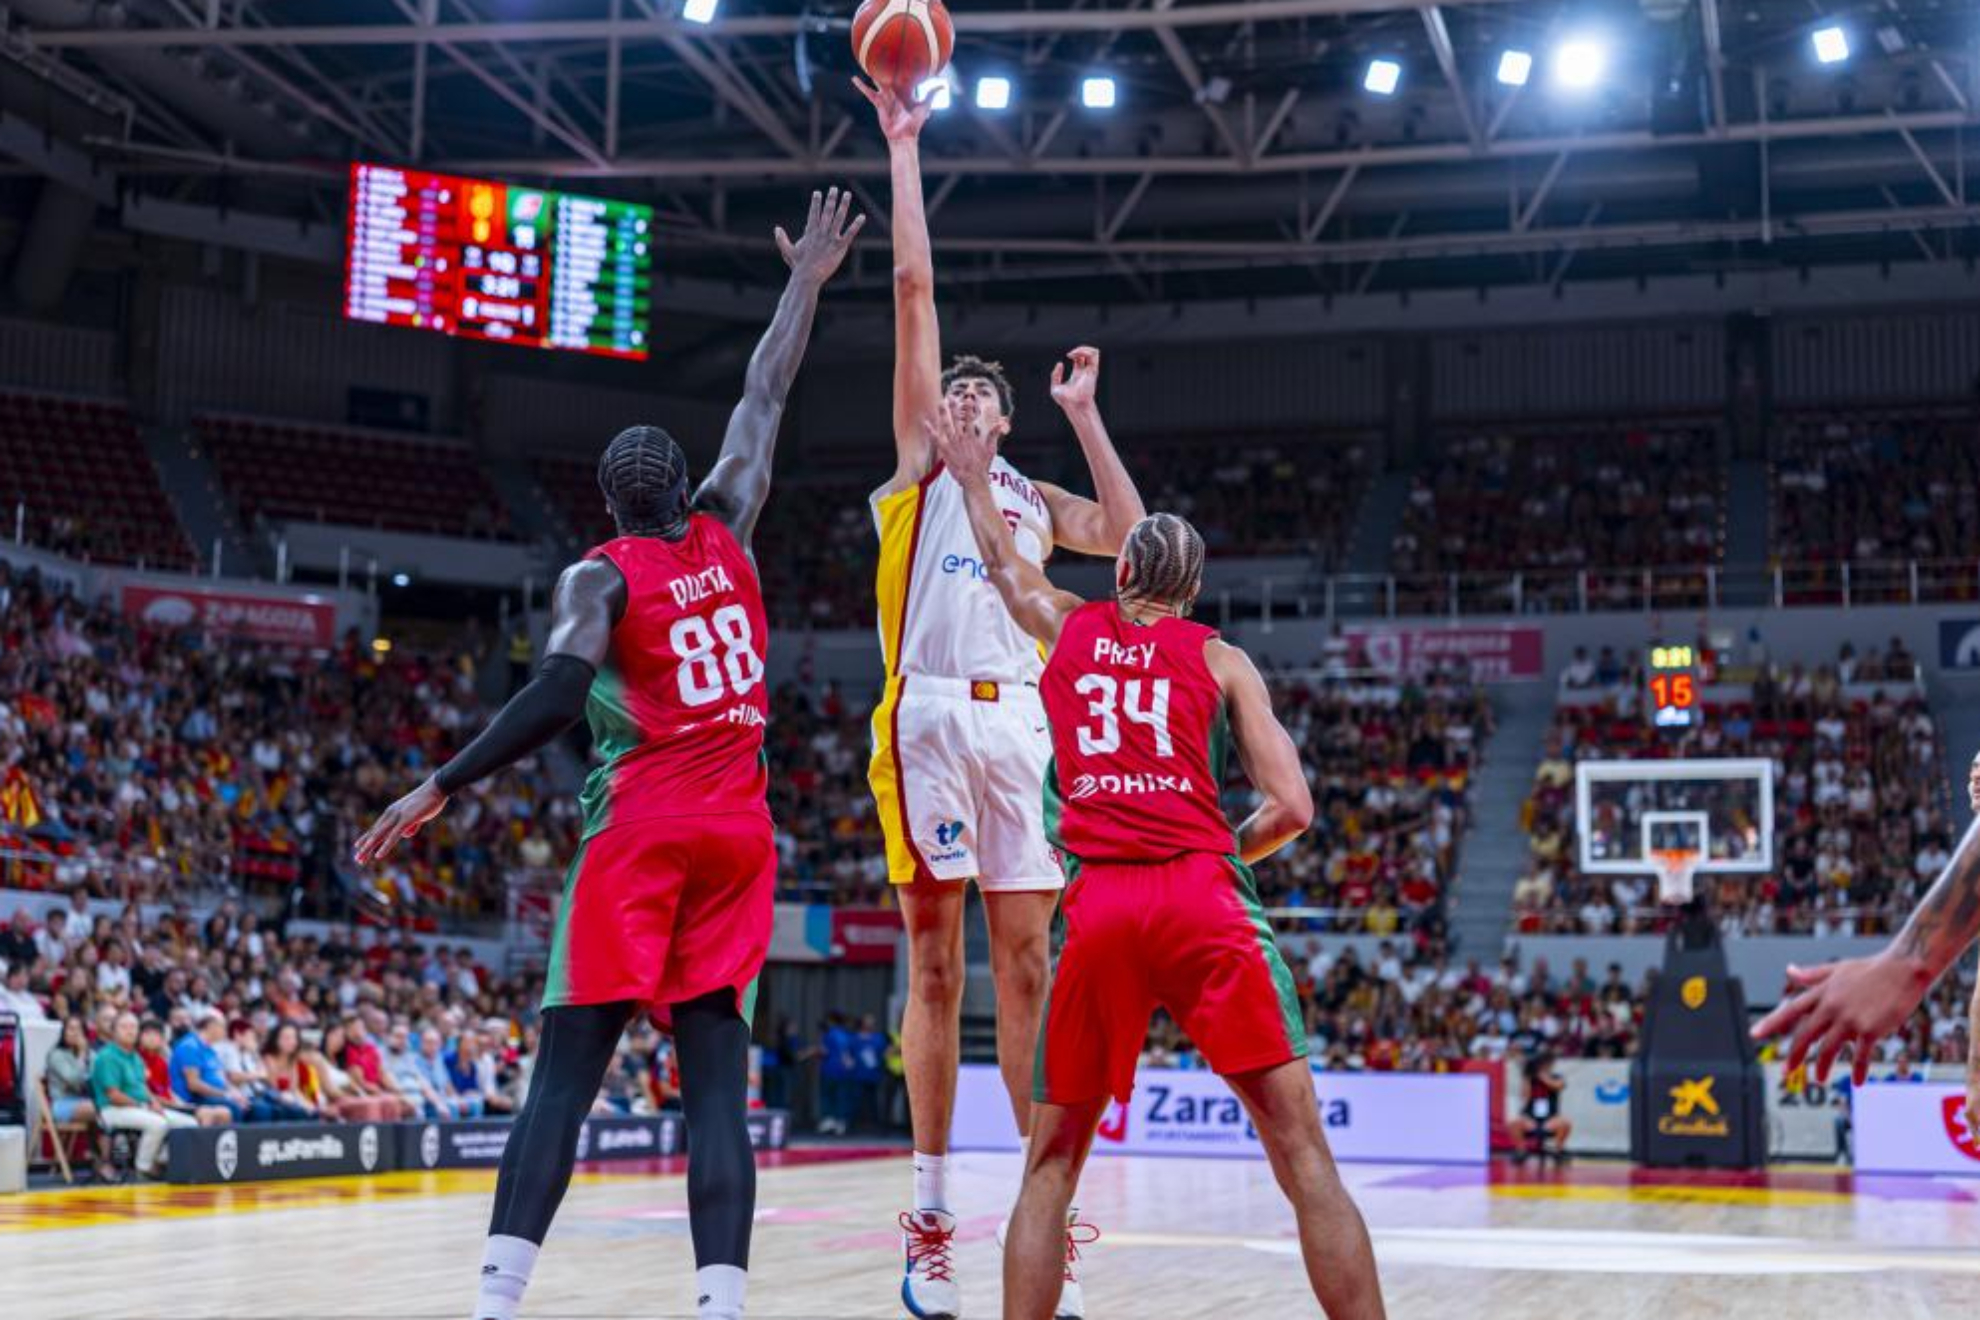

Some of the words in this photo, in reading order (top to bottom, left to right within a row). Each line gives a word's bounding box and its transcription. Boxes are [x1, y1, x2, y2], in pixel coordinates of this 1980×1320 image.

[669, 565, 735, 610] QUETA
[669, 603, 765, 707] 88
[1094, 637, 1155, 669] PREY
[1074, 673, 1174, 757] 34
[1649, 672, 1694, 710] 15
[1146, 1085, 1351, 1139] Zaraa
